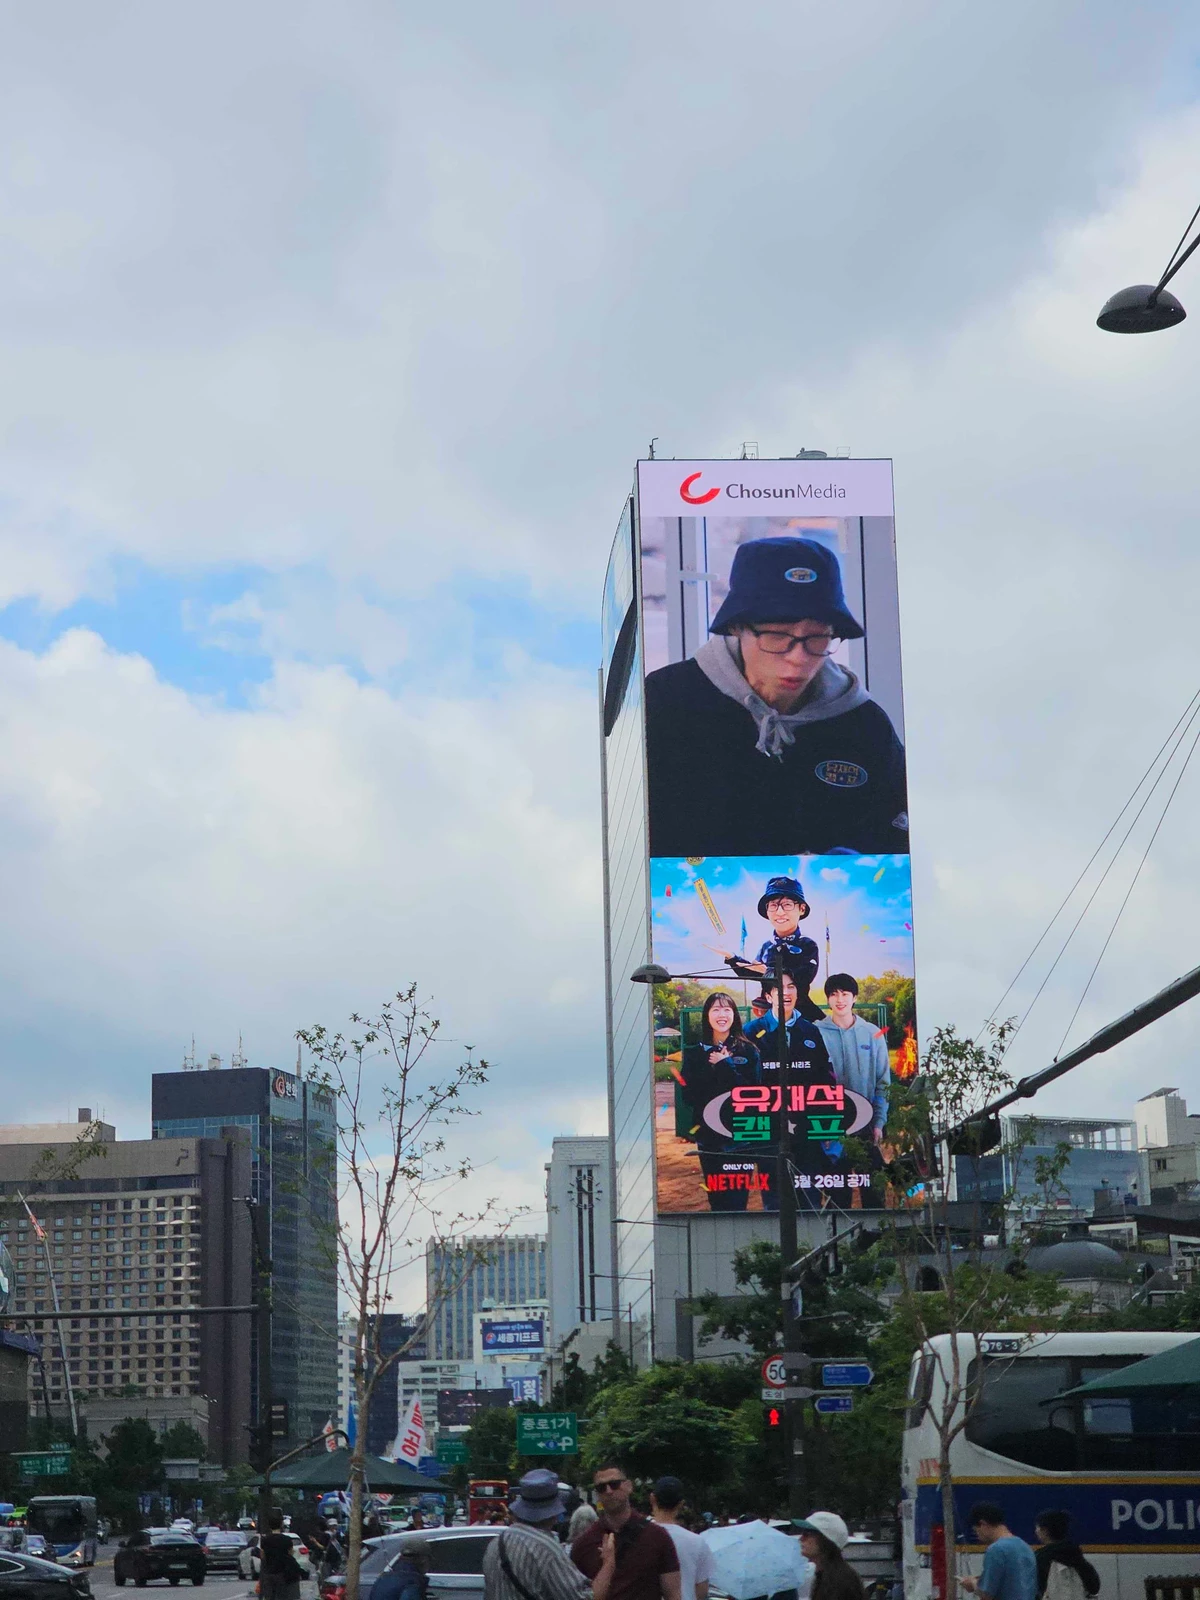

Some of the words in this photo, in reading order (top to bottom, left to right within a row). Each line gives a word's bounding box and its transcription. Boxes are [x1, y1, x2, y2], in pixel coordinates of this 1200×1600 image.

[791, 1061, 811, 1069] 시리즈
[731, 1084, 845, 1113] 유재석
[722, 1163, 742, 1171] ONLY
[707, 1173, 770, 1191] NETFLIX
[814, 1174, 845, 1188] 26일
[847, 1174, 871, 1188] 공개
[521, 1416, 572, 1431] 종로1가
[1111, 1498, 1200, 1530] POLI
